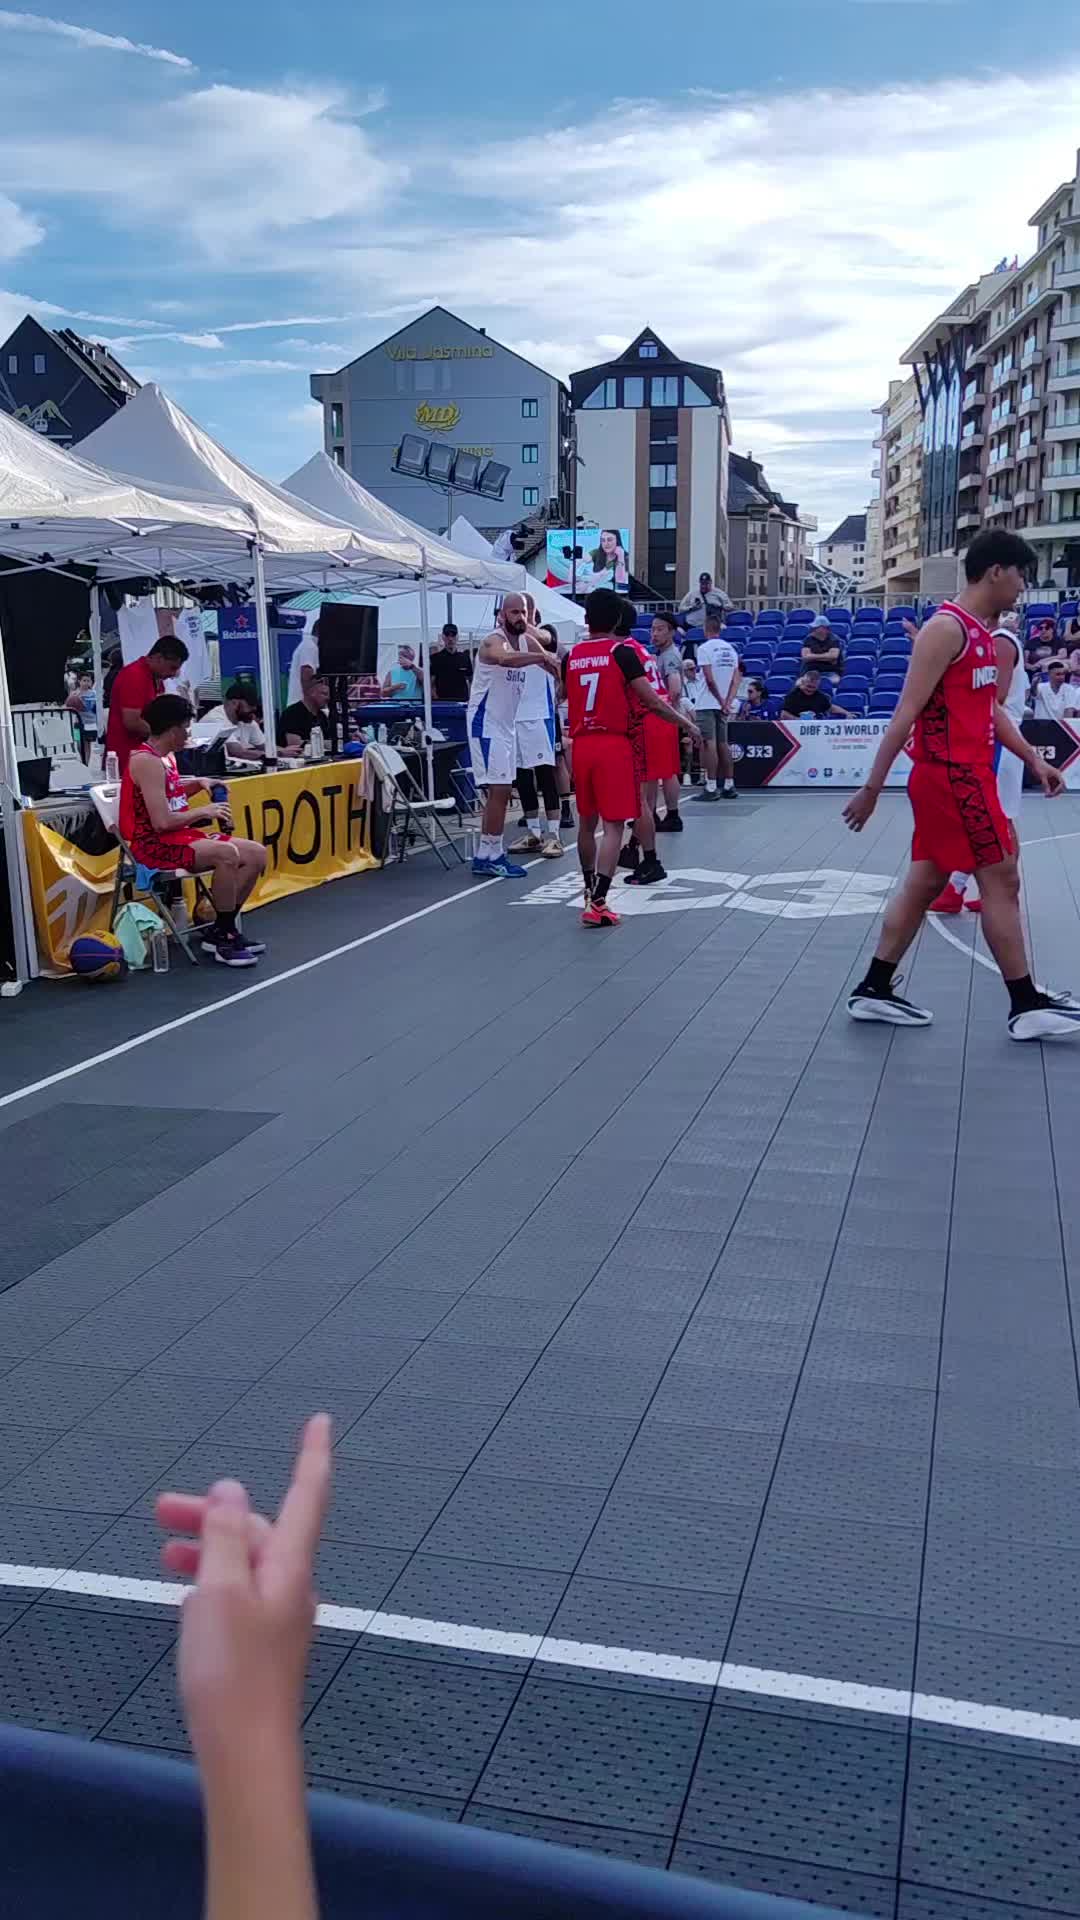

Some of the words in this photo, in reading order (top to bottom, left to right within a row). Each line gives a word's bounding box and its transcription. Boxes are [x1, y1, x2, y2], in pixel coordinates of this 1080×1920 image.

[569, 655, 610, 670] SHOFWAN
[580, 672, 600, 712] 7
[824, 725, 841, 736] 3x3
[844, 725, 879, 736] WORLD
